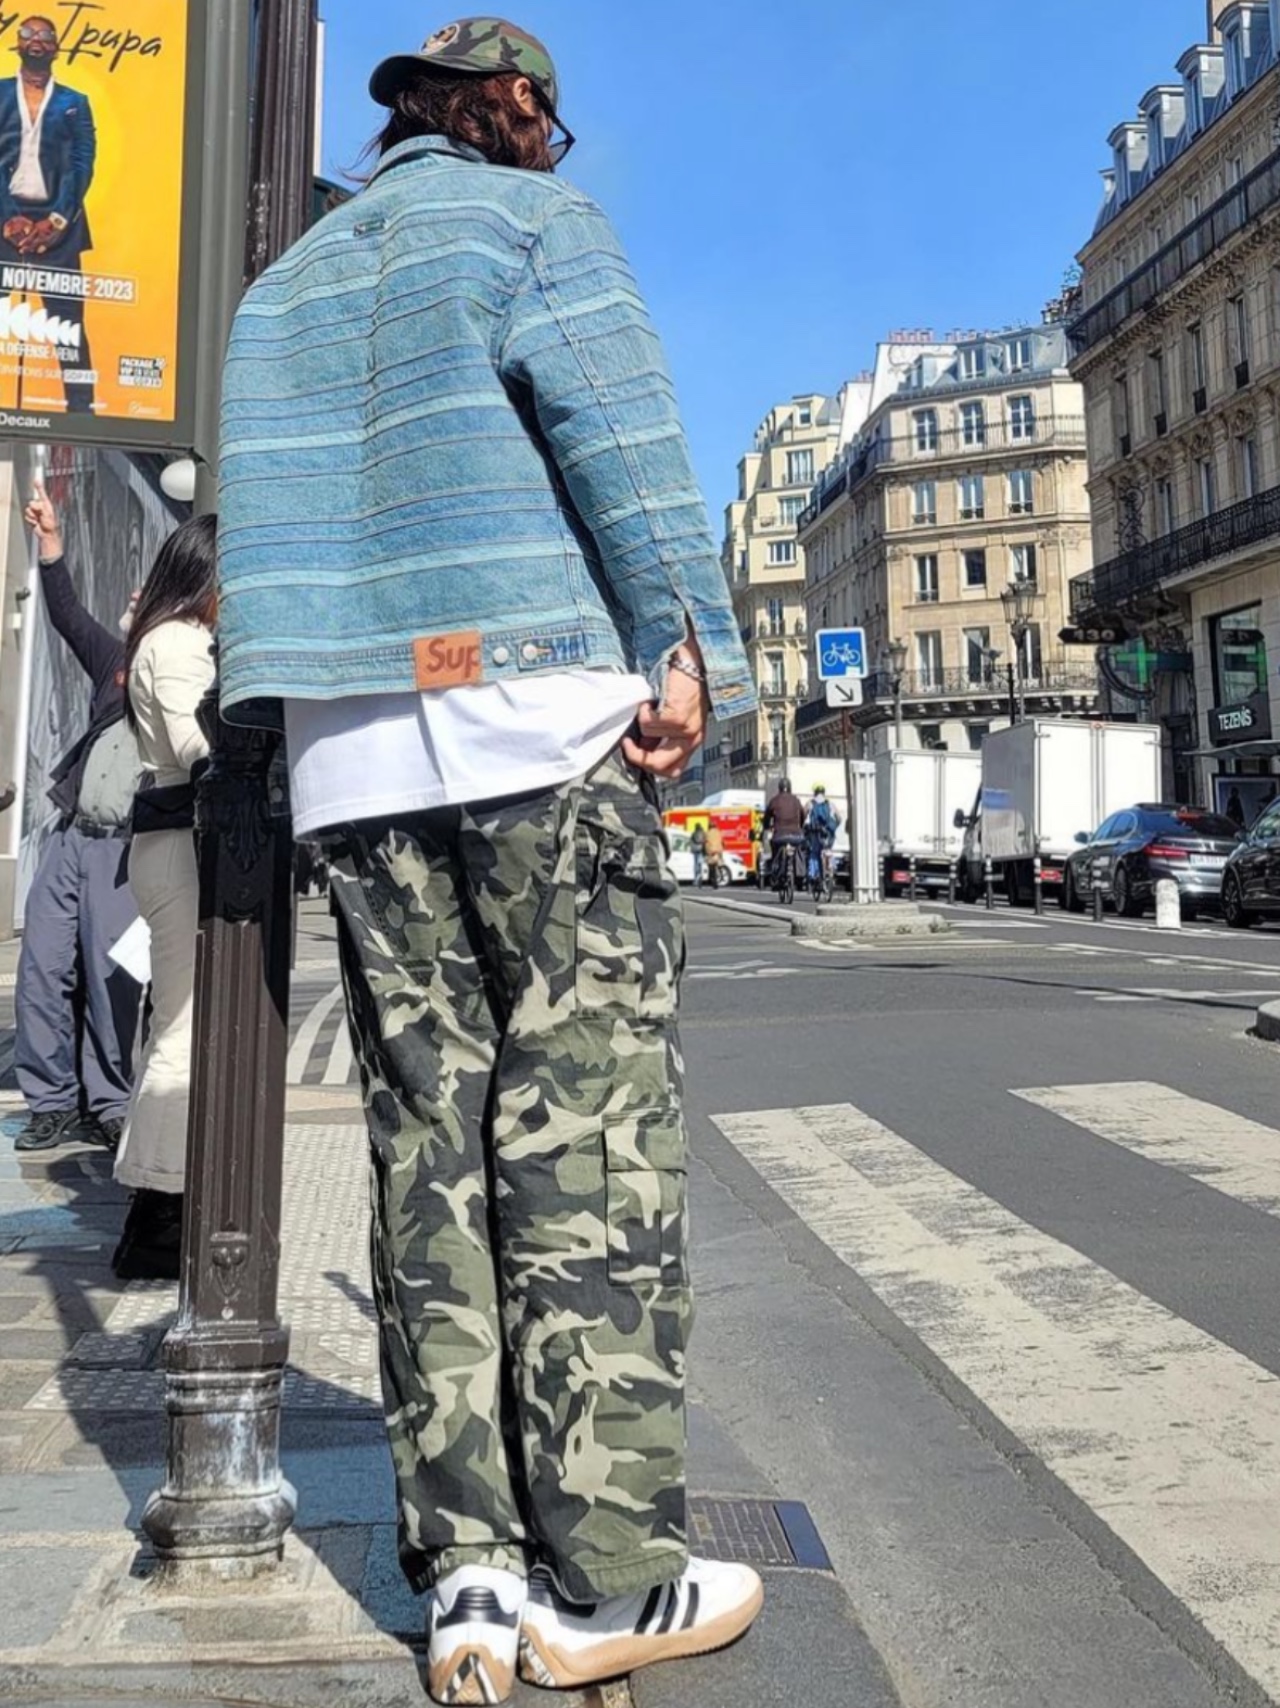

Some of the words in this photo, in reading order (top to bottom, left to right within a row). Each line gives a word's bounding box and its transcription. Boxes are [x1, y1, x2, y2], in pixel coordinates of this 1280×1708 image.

[2, 267, 91, 295] NOVEMBRE
[94, 277, 133, 300] 2023
[1074, 628, 1115, 641] 130
